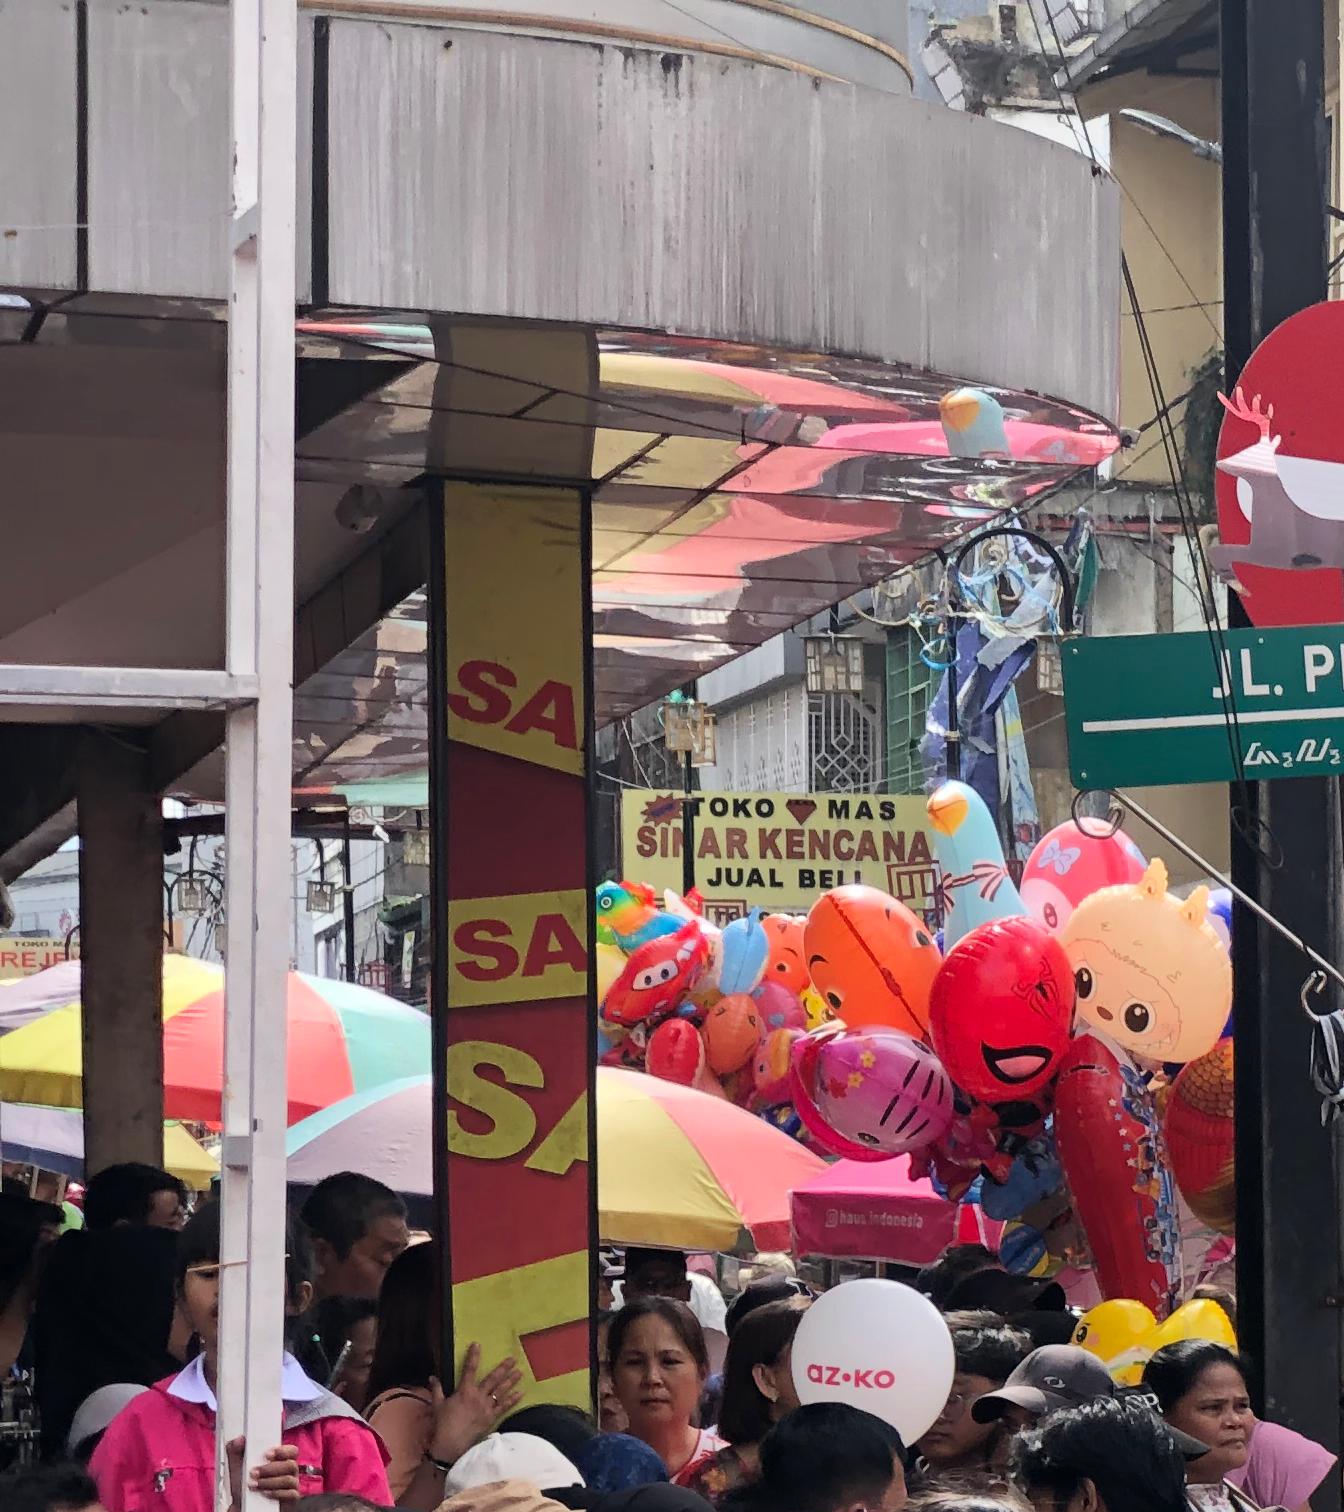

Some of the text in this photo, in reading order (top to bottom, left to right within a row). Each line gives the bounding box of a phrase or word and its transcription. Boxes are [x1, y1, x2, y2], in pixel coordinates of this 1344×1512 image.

[1212, 648, 1284, 699] JL.
[680, 796, 775, 818] TOKO
[828, 799, 896, 821] MAS
[757, 827, 933, 863] KENCANA
[706, 867, 862, 889] JUAL BELI
